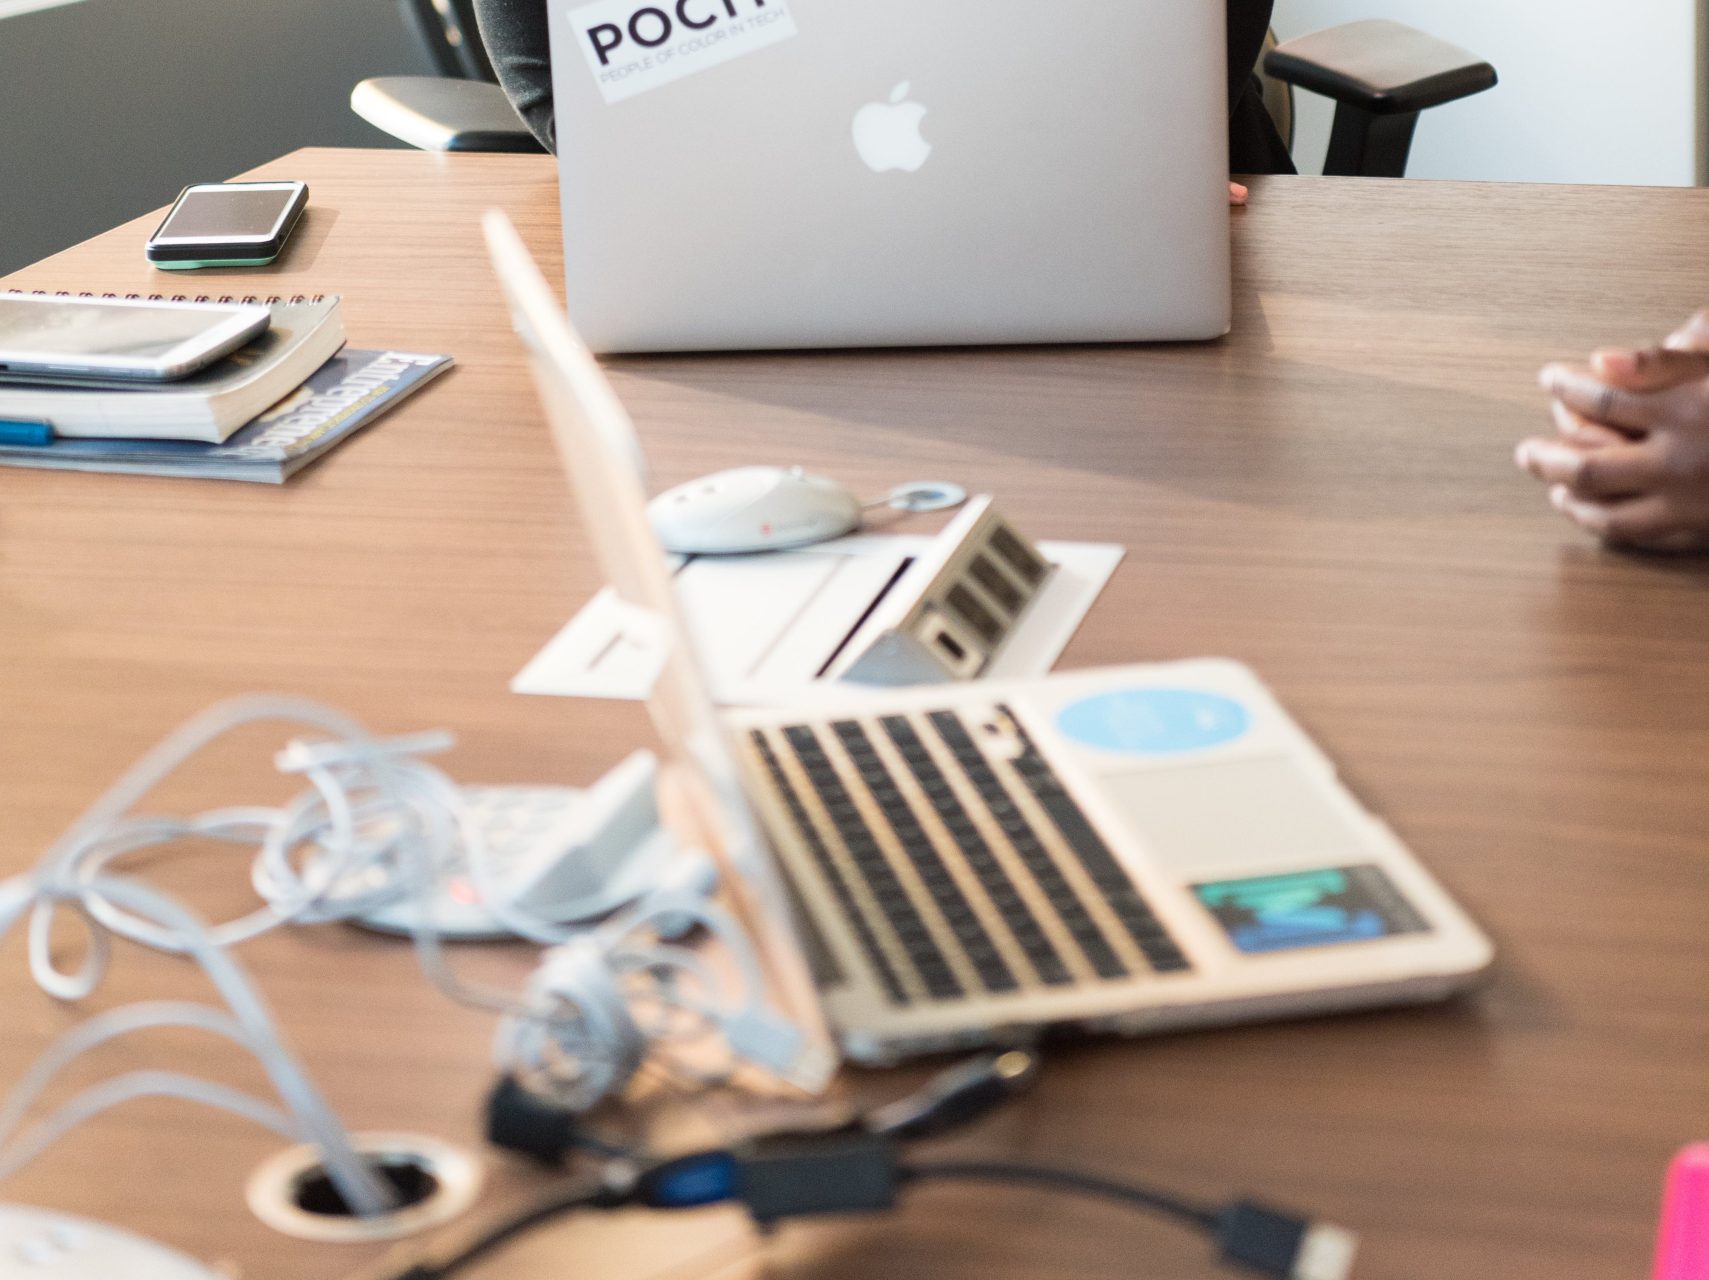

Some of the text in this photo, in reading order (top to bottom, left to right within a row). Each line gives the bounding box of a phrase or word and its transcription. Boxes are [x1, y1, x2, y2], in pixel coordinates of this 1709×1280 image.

[600, 8, 786, 83] PEOPLE OF COLOR IN TECH
